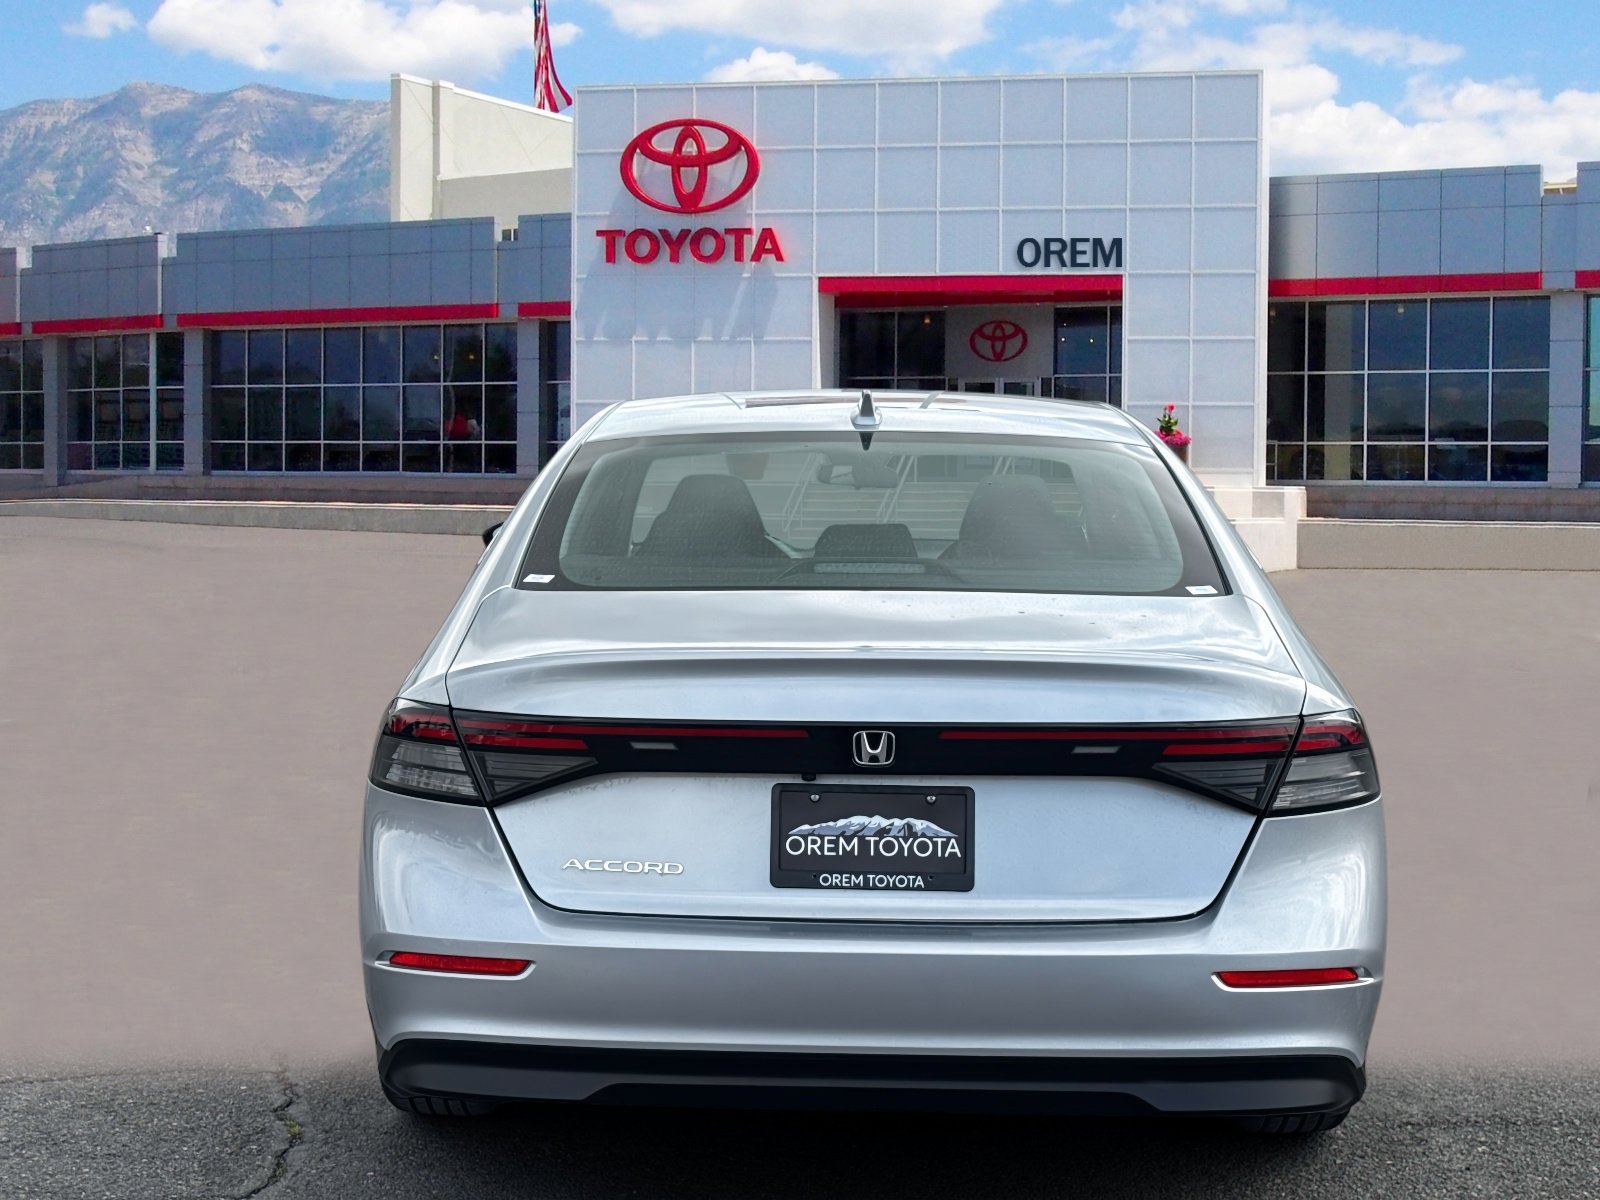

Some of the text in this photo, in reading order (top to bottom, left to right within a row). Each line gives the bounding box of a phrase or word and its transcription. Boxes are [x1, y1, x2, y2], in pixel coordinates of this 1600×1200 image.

[596, 227, 785, 264] TOYOTA
[1016, 237, 1123, 268] OREM
[785, 835, 962, 858] OREM TOYOTA
[561, 858, 684, 875] ACCORD
[819, 873, 925, 889] OREM TOYOTA
